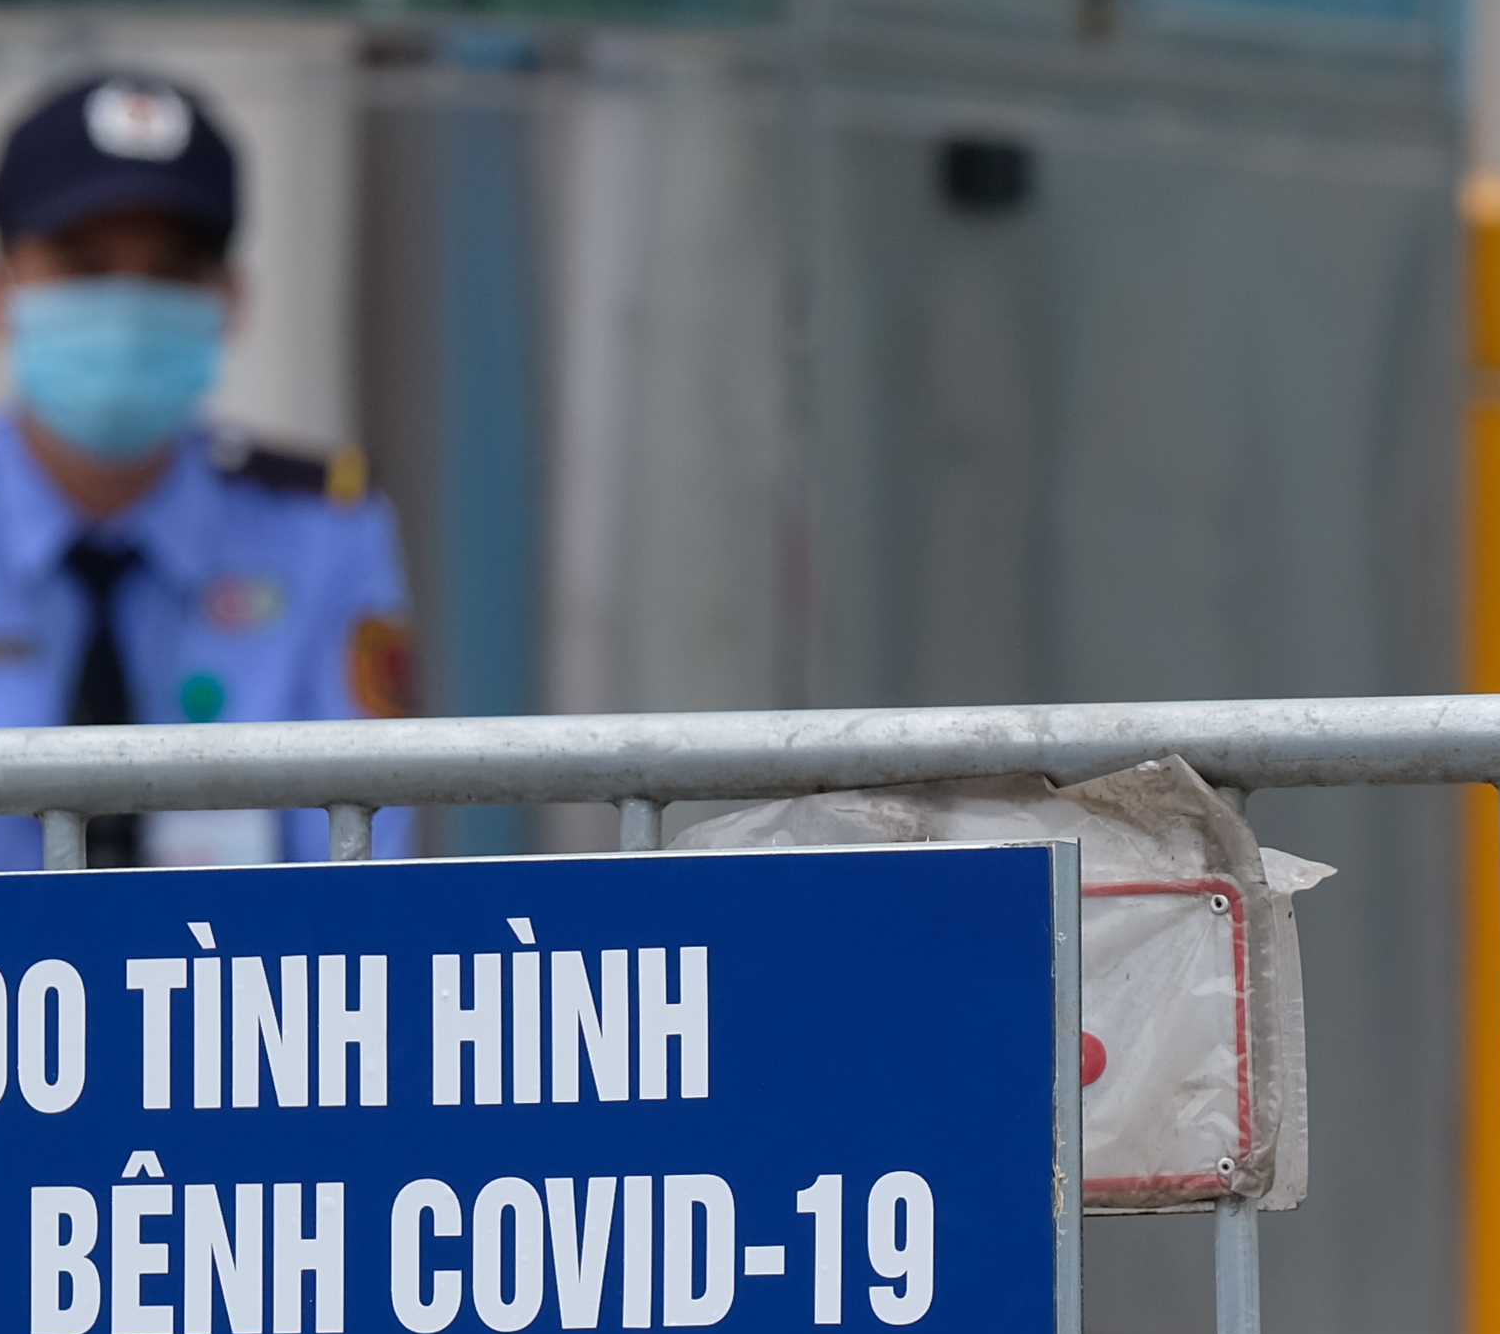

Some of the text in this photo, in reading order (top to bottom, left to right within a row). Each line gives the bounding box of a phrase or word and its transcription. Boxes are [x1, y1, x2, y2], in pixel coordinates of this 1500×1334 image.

[126, 921, 388, 1110] TÌNH
[432, 917, 709, 1106] HÌNH
[390, 1170, 935, 1334] COVID-19
